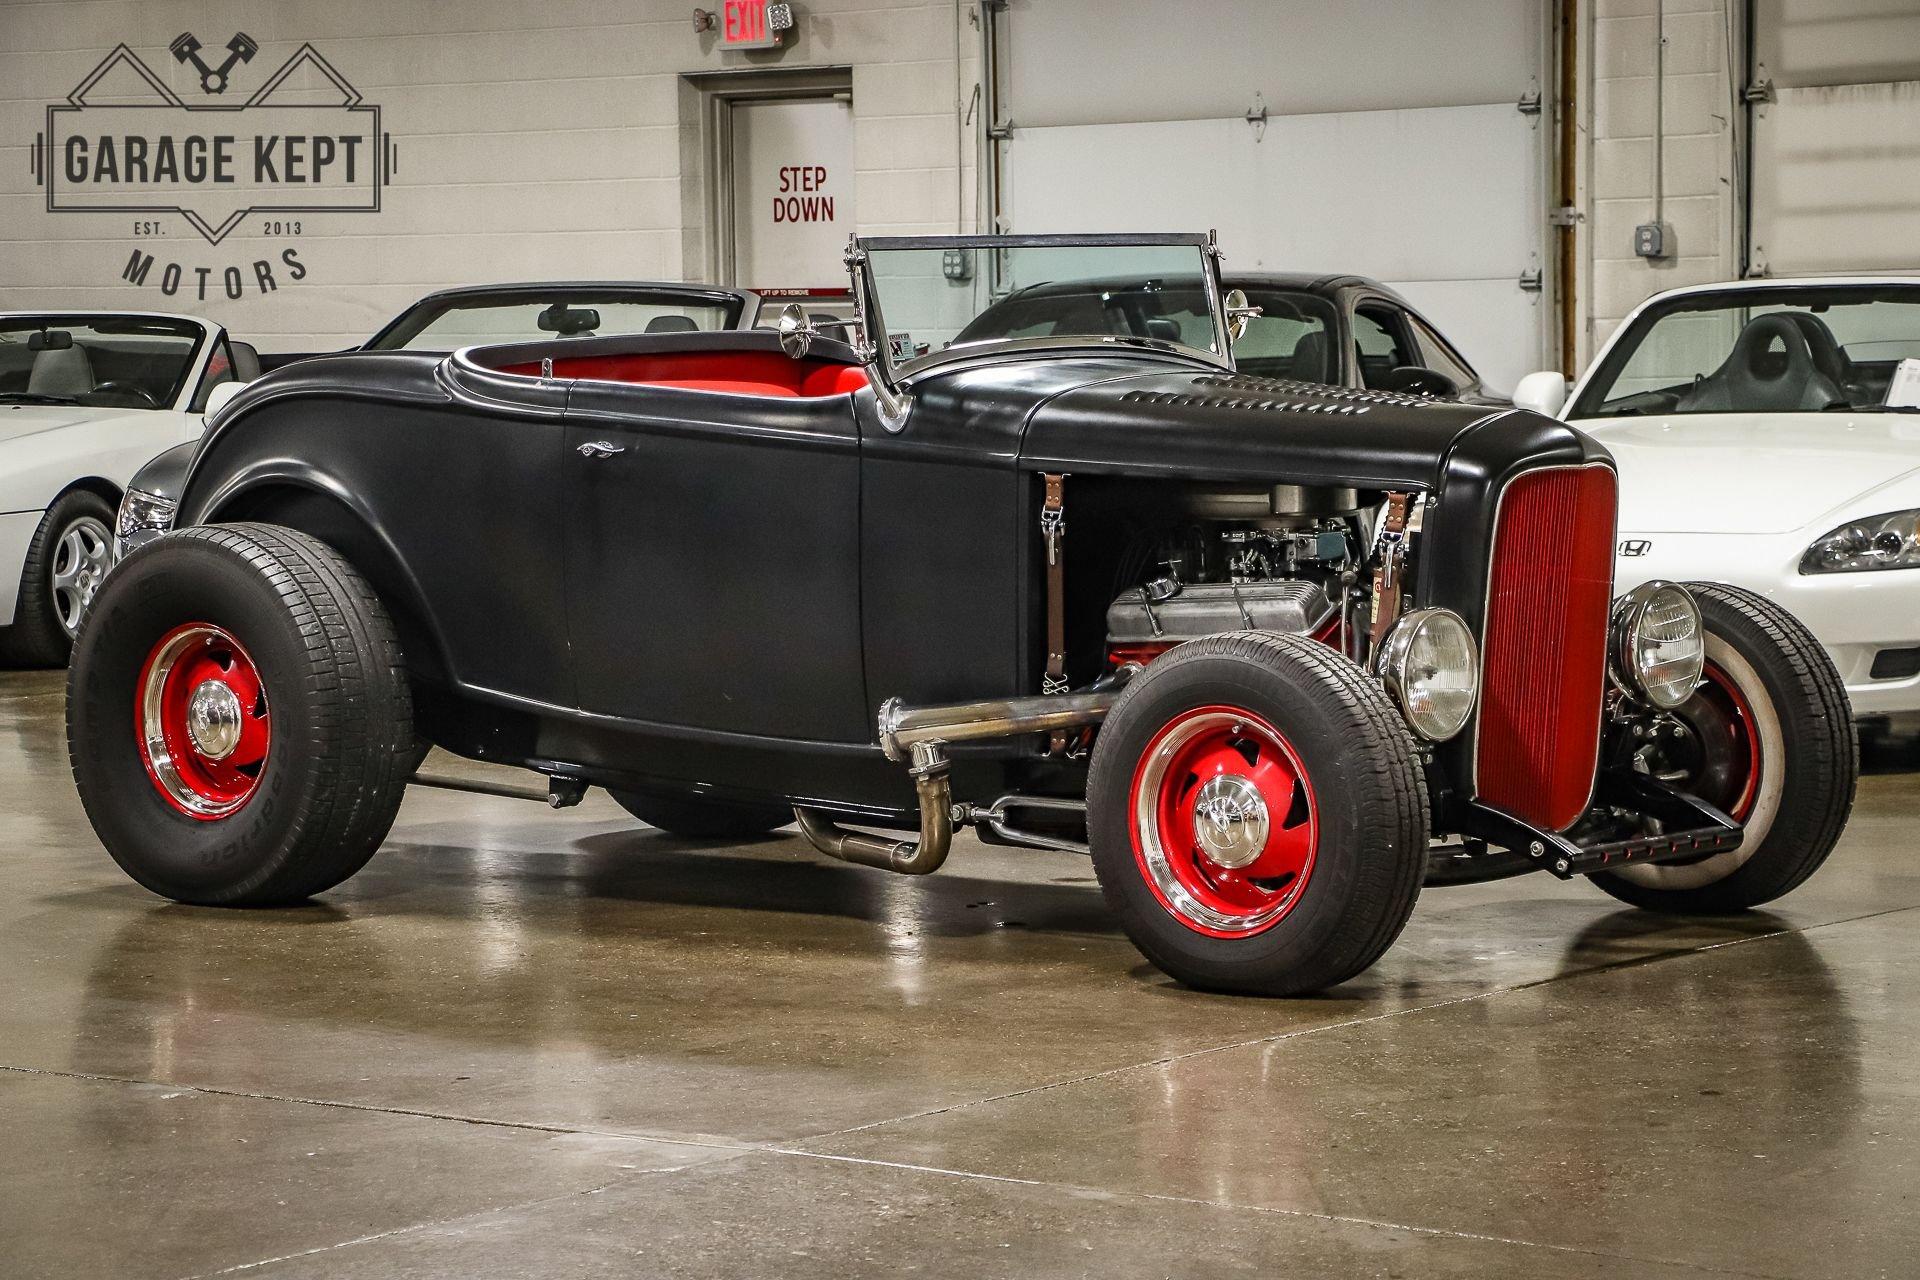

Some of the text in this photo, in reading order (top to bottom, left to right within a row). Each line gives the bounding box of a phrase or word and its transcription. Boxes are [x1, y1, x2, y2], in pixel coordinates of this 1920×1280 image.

[724, 0, 766, 42] EXIT
[779, 166, 826, 193] STEP
[773, 197, 834, 222] DOWN
